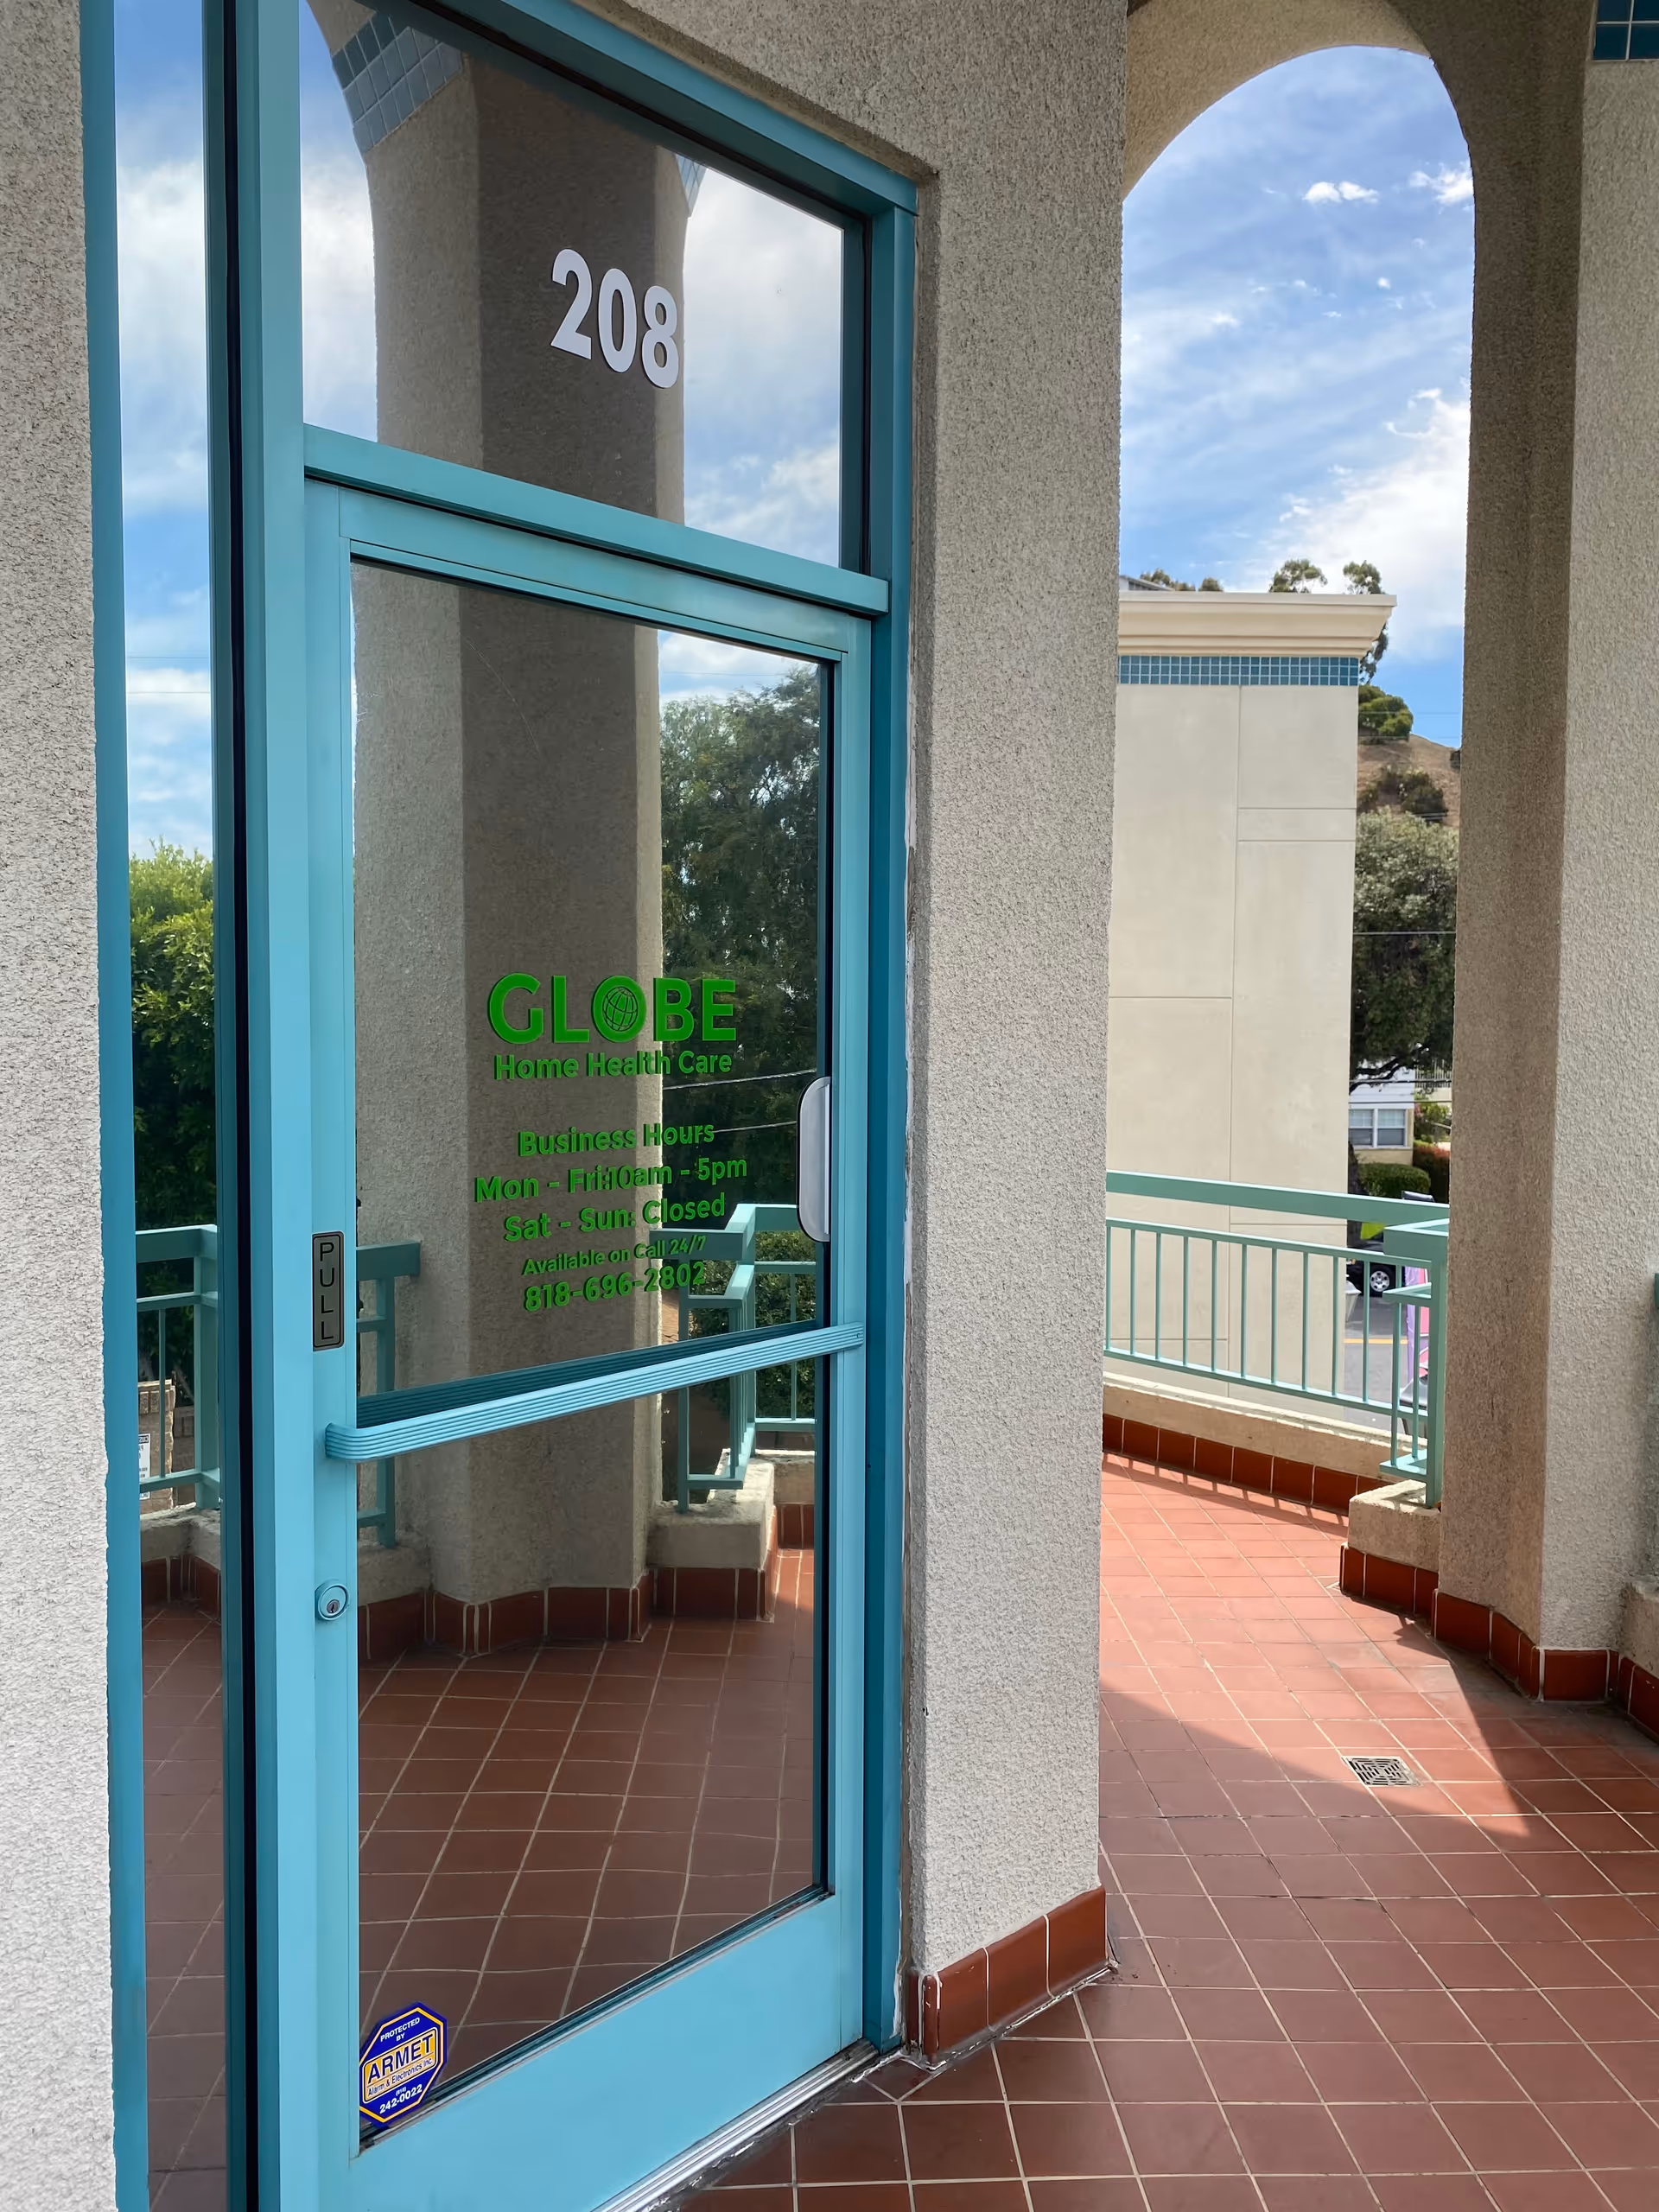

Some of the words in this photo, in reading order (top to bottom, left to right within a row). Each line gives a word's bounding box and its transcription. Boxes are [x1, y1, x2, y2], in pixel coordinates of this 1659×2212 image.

[550, 249, 679, 388] 208
[487, 972, 738, 1045] GLOBE
[493, 1053, 580, 1080] Home
[586, 1050, 671, 1077] Health
[678, 1049, 733, 1075] Care
[518, 1126, 638, 1157] Business
[643, 1123, 715, 1147] Hours
[474, 1175, 540, 1204] Mon
[547, 1180, 561, 1190] -
[696, 1156, 748, 1186] 5pm
[504, 1212, 552, 1243] Sat
[559, 1220, 571, 1229] -
[579, 1205, 636, 1233] Sun:
[642, 1192, 726, 1225] Closed
[521, 1250, 606, 1276] Available
[608, 1248, 631, 1263] on
[633, 1239, 665, 1259] Call
[670, 1234, 707, 1255] 24/7
[319, 1242, 335, 1340] PULL
[523, 1261, 706, 1312] 818-696-2802
[380, 2017, 420, 2042] PROTECTED
[396, 2032, 405, 2042] BY
[367, 2033, 434, 2084] ARMET
[368, 2083, 385, 2096] Alarm
[386, 2079, 391, 2088] &
[391, 2063, 423, 2084] Electronics
[379, 2084, 423, 2113] 242-0022
